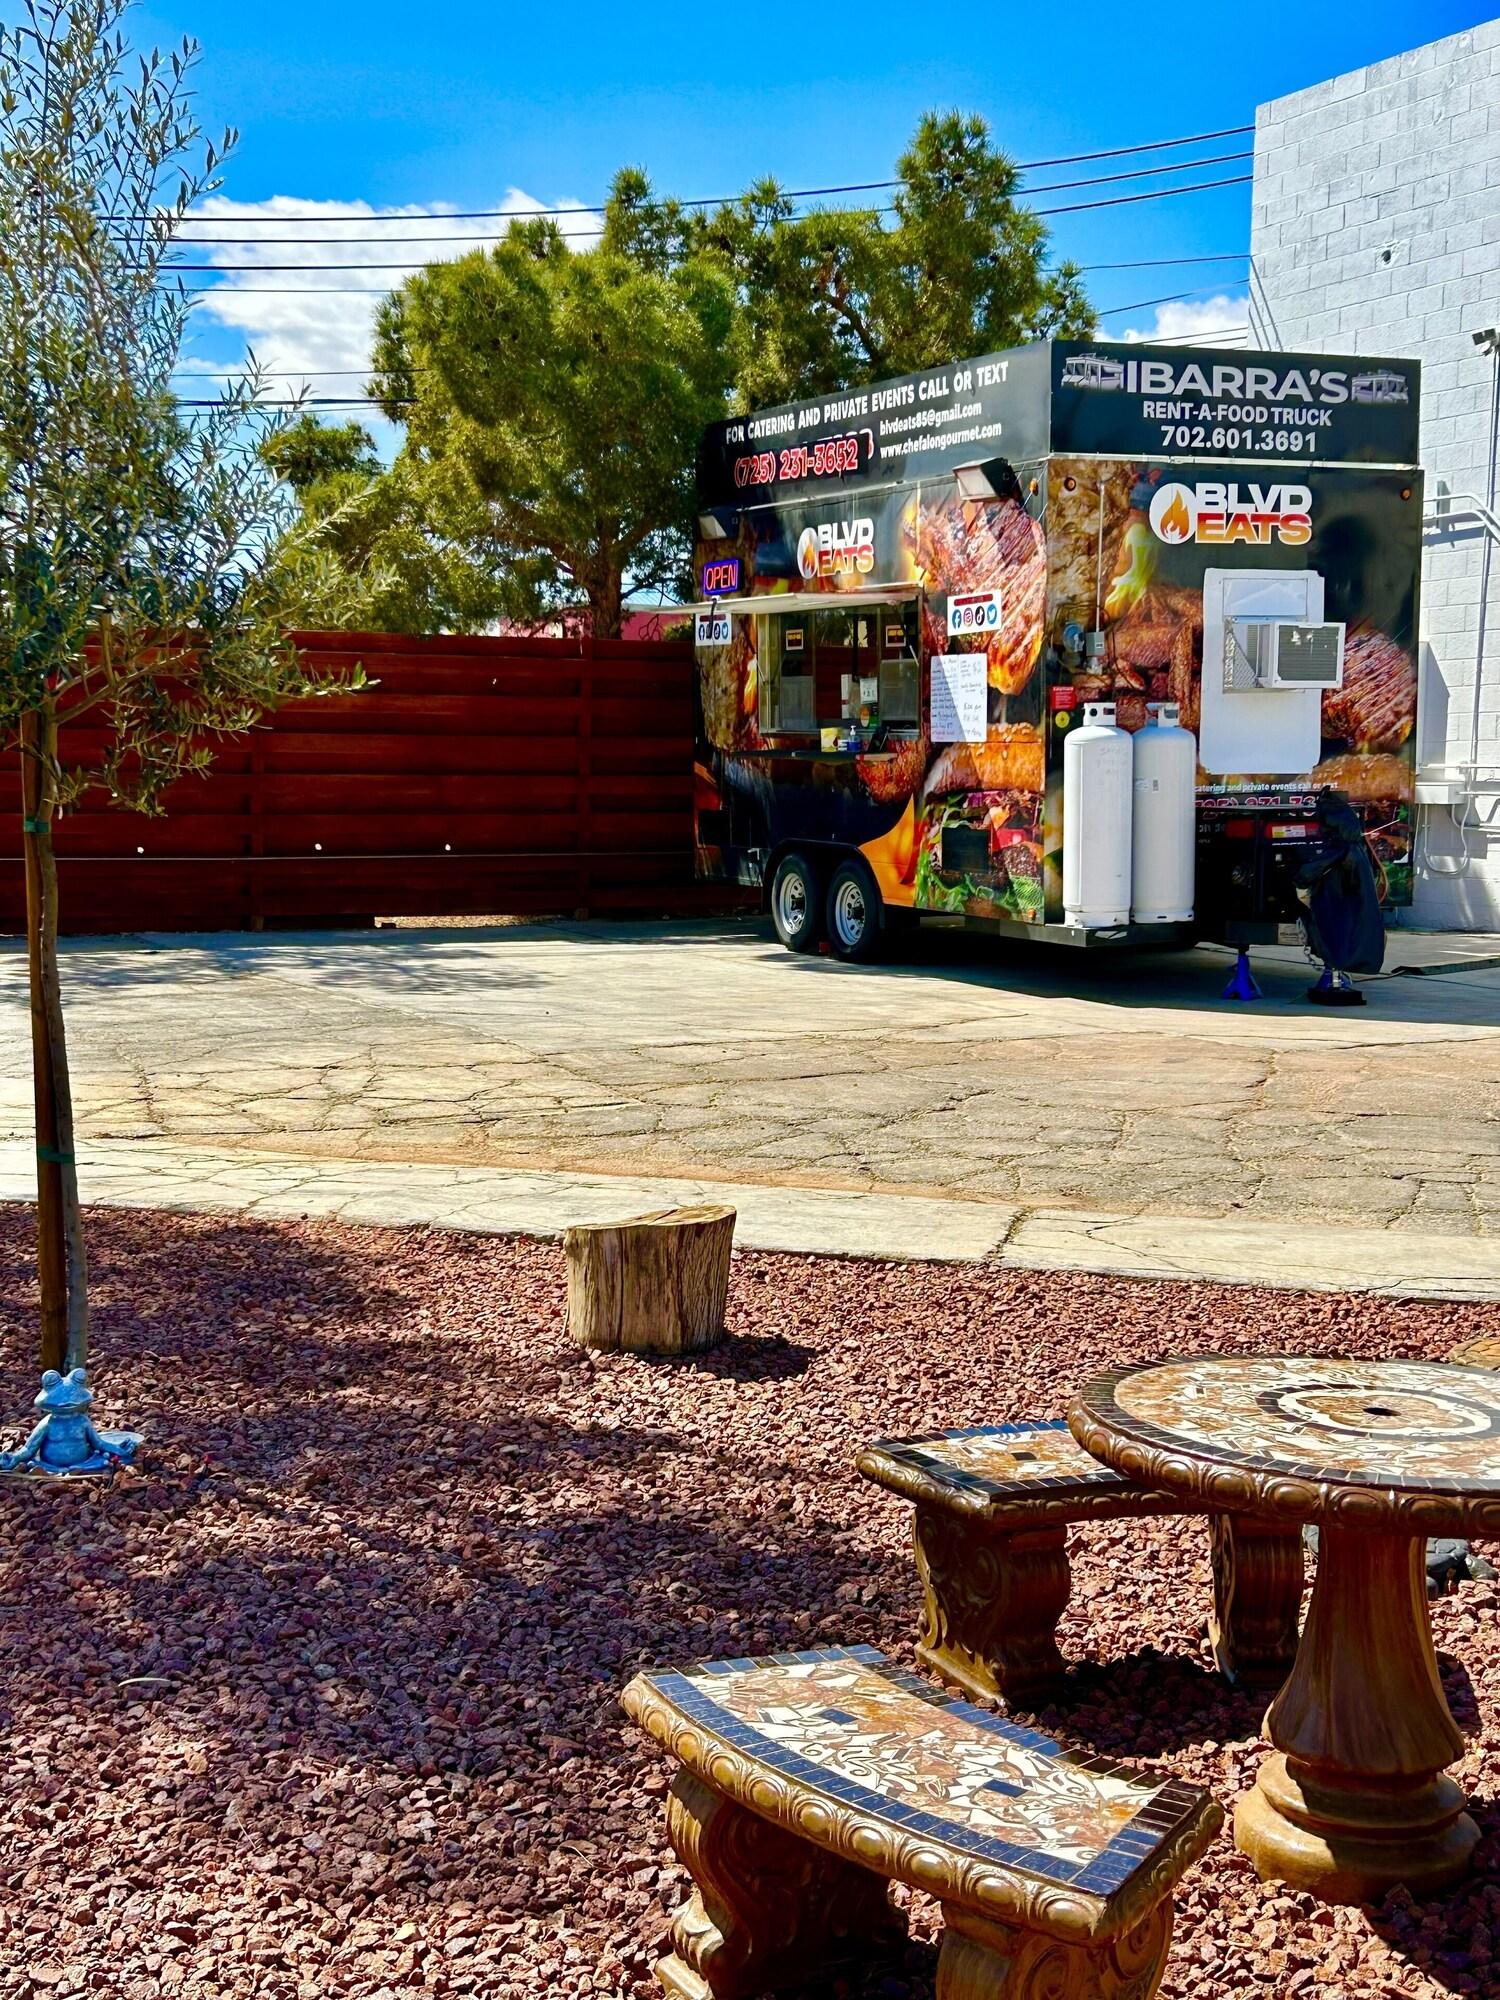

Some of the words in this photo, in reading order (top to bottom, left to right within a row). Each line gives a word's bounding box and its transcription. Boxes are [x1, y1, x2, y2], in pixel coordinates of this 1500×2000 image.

[1126, 360, 1349, 404] IBARRA'S
[726, 425, 744, 444] FOR
[748, 413, 795, 440] CATERING
[798, 407, 820, 430] AND
[824, 395, 868, 423] PRIVATE
[872, 384, 915, 412] EVENTS
[918, 375, 950, 400] CALL
[953, 370, 973, 392] OR
[976, 361, 1009, 387] TEXT
[879, 402, 982, 436] blvdeats85@gmail.com
[1143, 400, 1268, 425] RENT-A-FOOD
[1272, 407, 1332, 427] TRUCK
[880, 422, 1002, 459] www.chefalongourmet.com
[1160, 426, 1316, 453] 702.601.3691
[734, 451, 776, 488] (725)
[779, 438, 859, 480] 231-3652
[1195, 482, 1313, 515] BLVD
[817, 517, 875, 551] BLVD
[1195, 512, 1313, 546] EATS
[705, 564, 737, 591] OPEN
[817, 544, 875, 577] EATS
